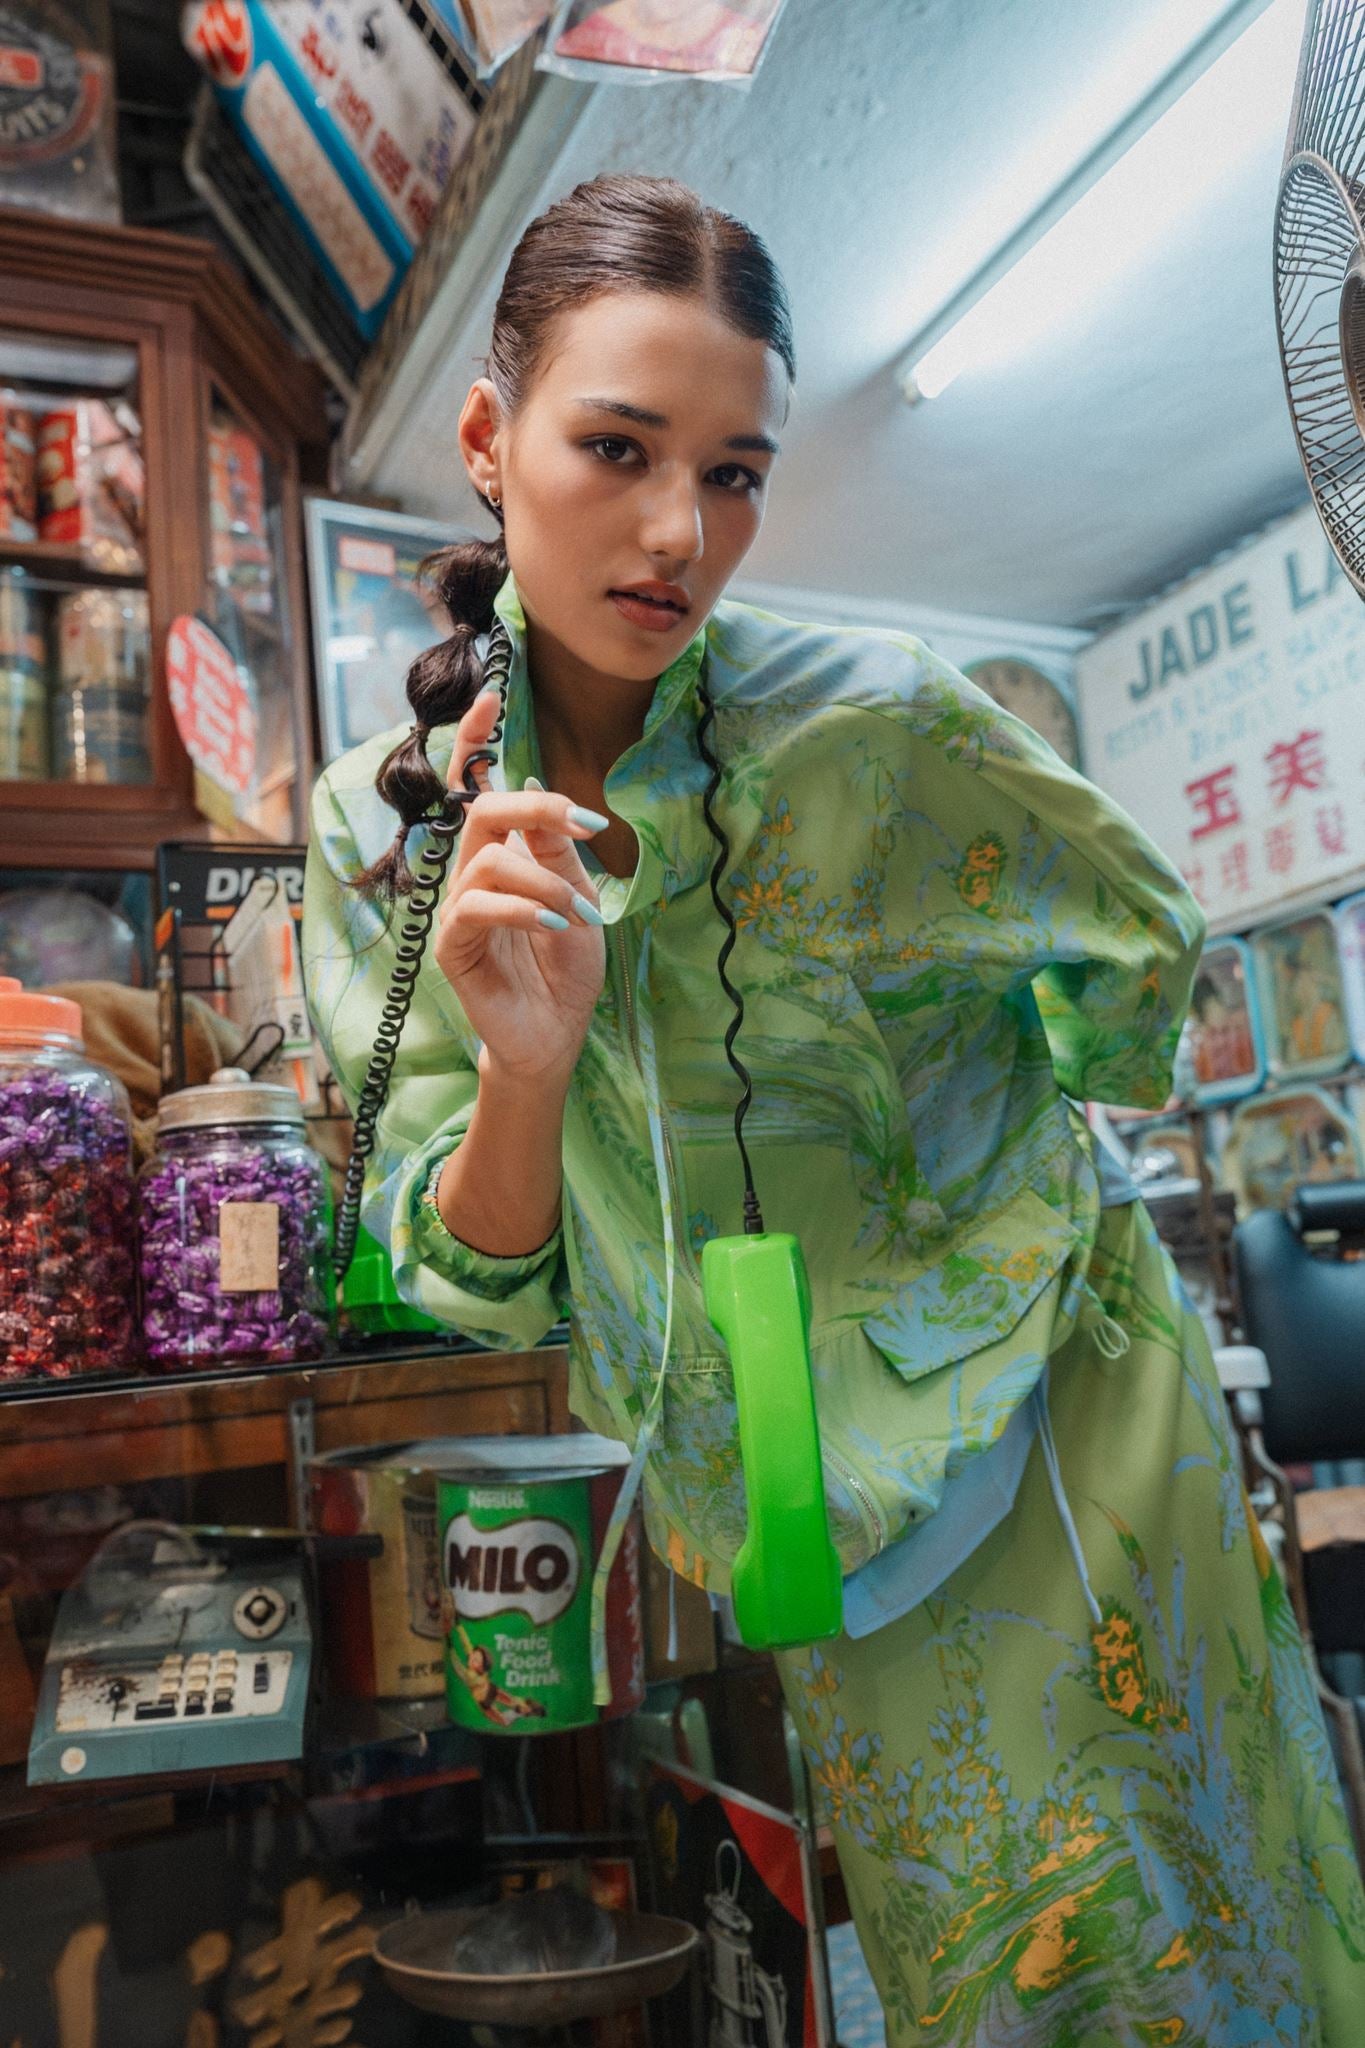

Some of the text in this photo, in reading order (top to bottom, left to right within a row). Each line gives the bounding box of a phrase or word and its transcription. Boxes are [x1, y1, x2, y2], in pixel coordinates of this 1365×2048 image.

[1129, 581, 1253, 700] JADE
[449, 1543, 569, 1593] MILO
[494, 1633, 548, 1651] Tonic
[500, 1650, 552, 1669] Food
[505, 1669, 561, 1688] Drink
